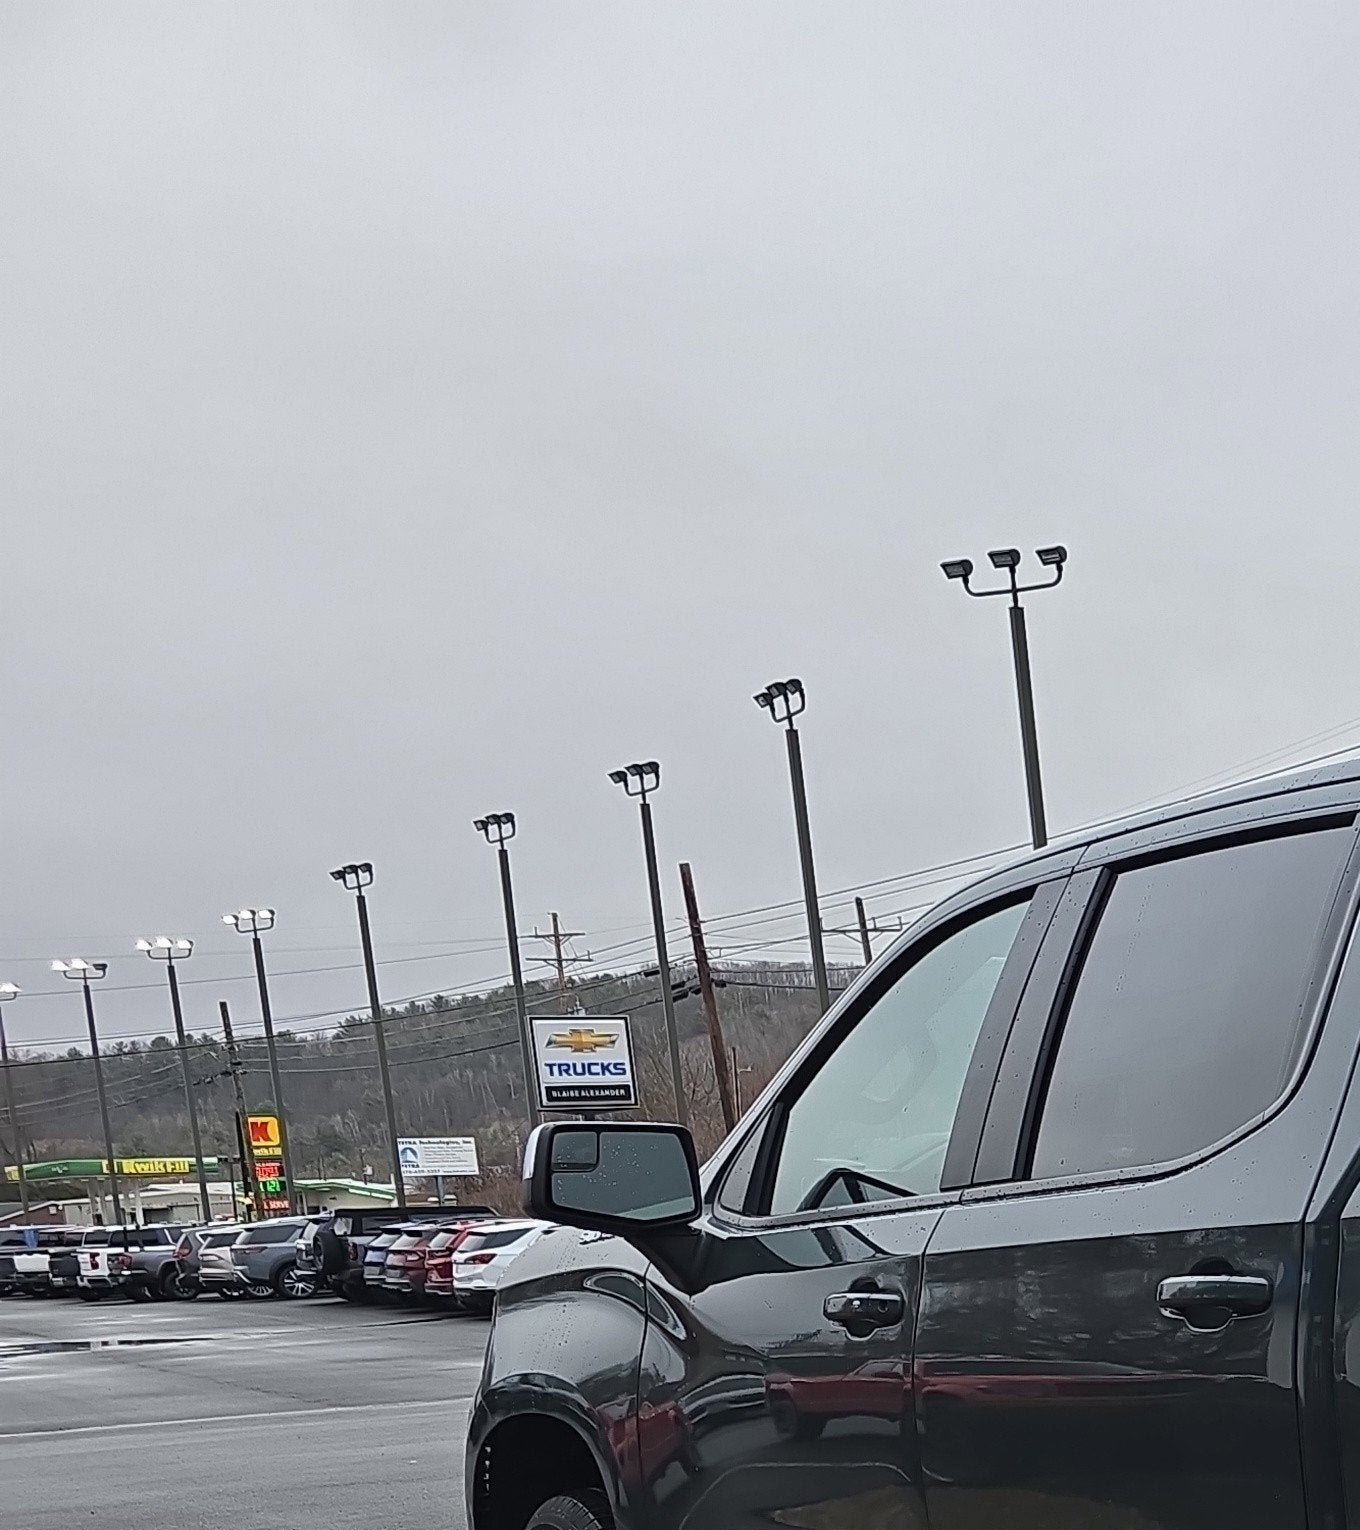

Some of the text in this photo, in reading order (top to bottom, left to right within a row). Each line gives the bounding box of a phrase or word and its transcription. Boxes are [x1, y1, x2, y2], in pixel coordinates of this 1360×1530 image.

[544, 1062, 627, 1077] TRUCKS
[551, 1088, 626, 1098] BLAISE ALEXANDER
